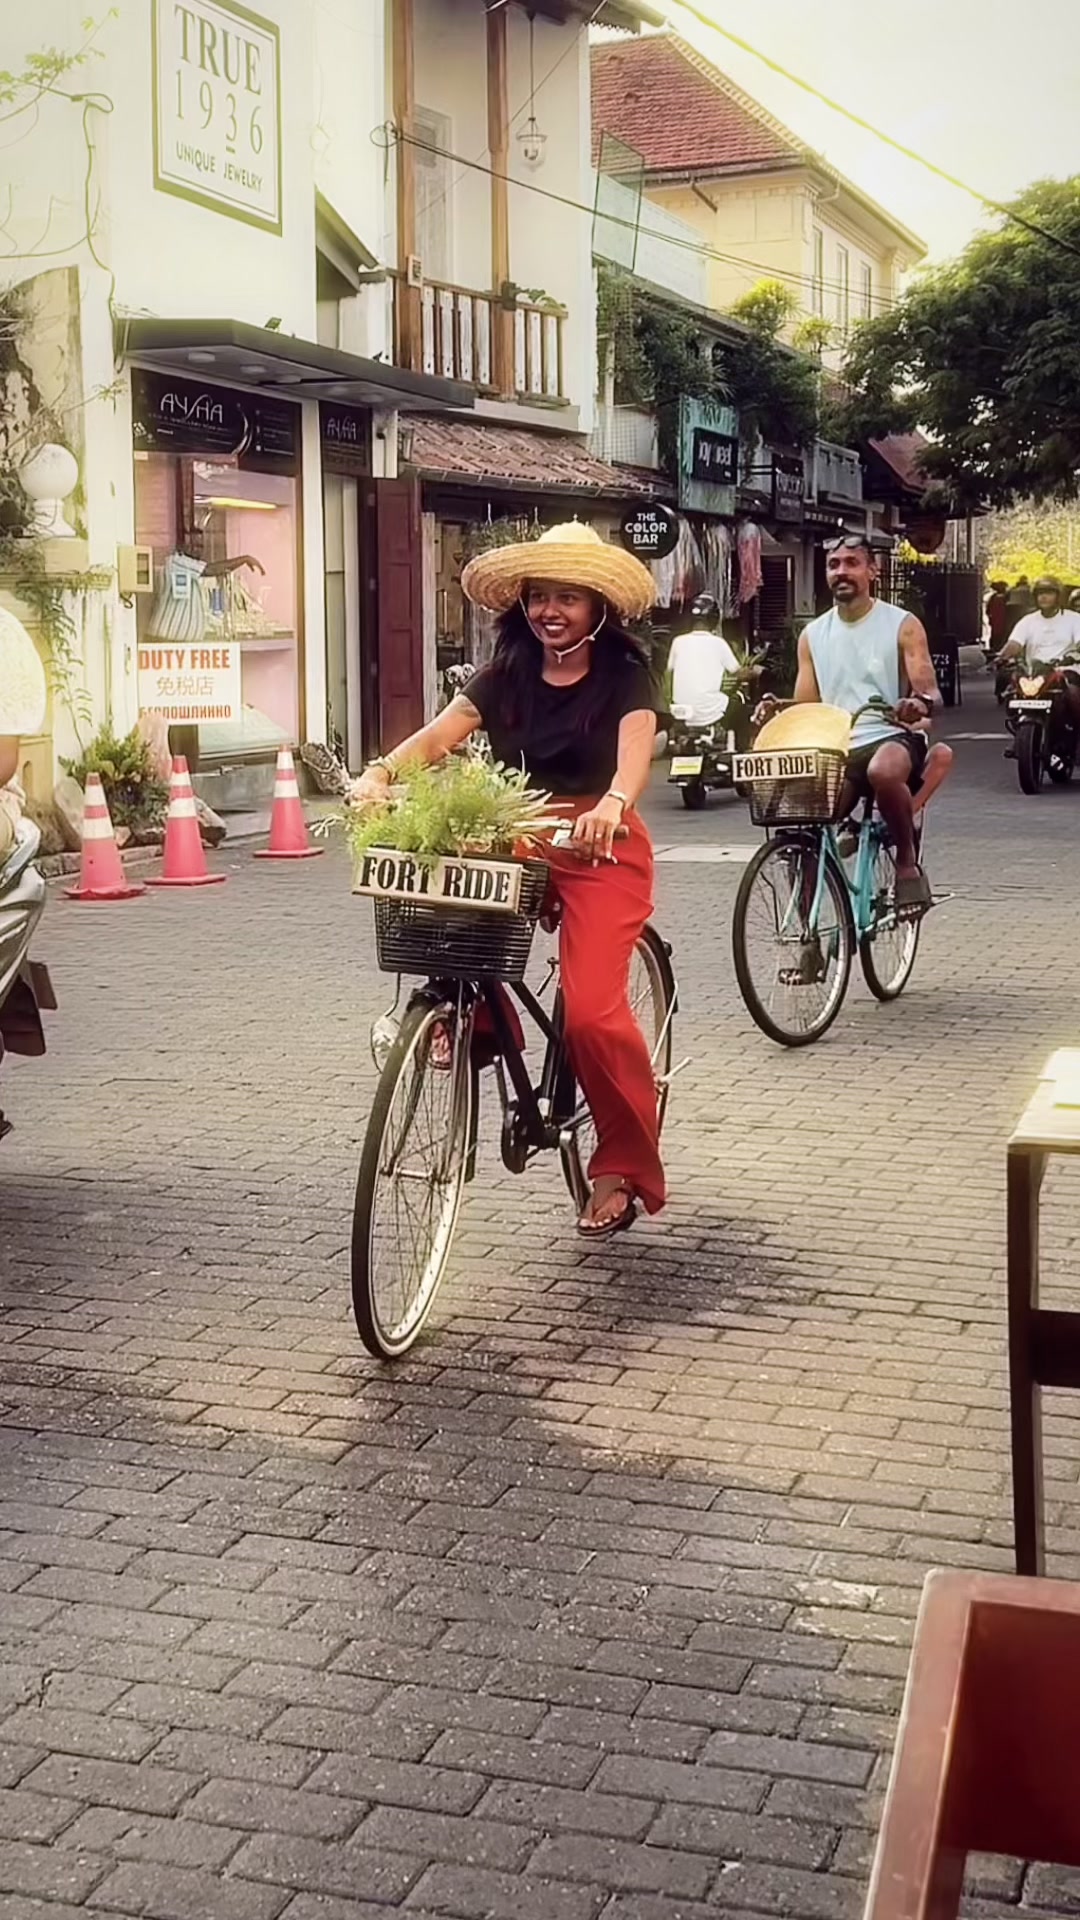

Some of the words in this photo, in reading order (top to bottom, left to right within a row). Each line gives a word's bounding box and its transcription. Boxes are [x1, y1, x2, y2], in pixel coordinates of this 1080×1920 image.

[175, 4, 262, 95] TRUE
[176, 69, 263, 154] 1936
[176, 141, 216, 173] UNIQUE
[223, 162, 264, 193] JEWELRY
[625, 522, 668, 533] COLOR
[637, 512, 656, 521] THE
[633, 533, 659, 545] BAR
[138, 649, 185, 671] DUTY
[191, 649, 231, 670] FREE
[157, 676, 215, 697] 免税店
[736, 757, 773, 778] FORT
[778, 755, 814, 775] RIDE
[360, 855, 432, 895] FORT
[442, 863, 511, 903] RIDE
